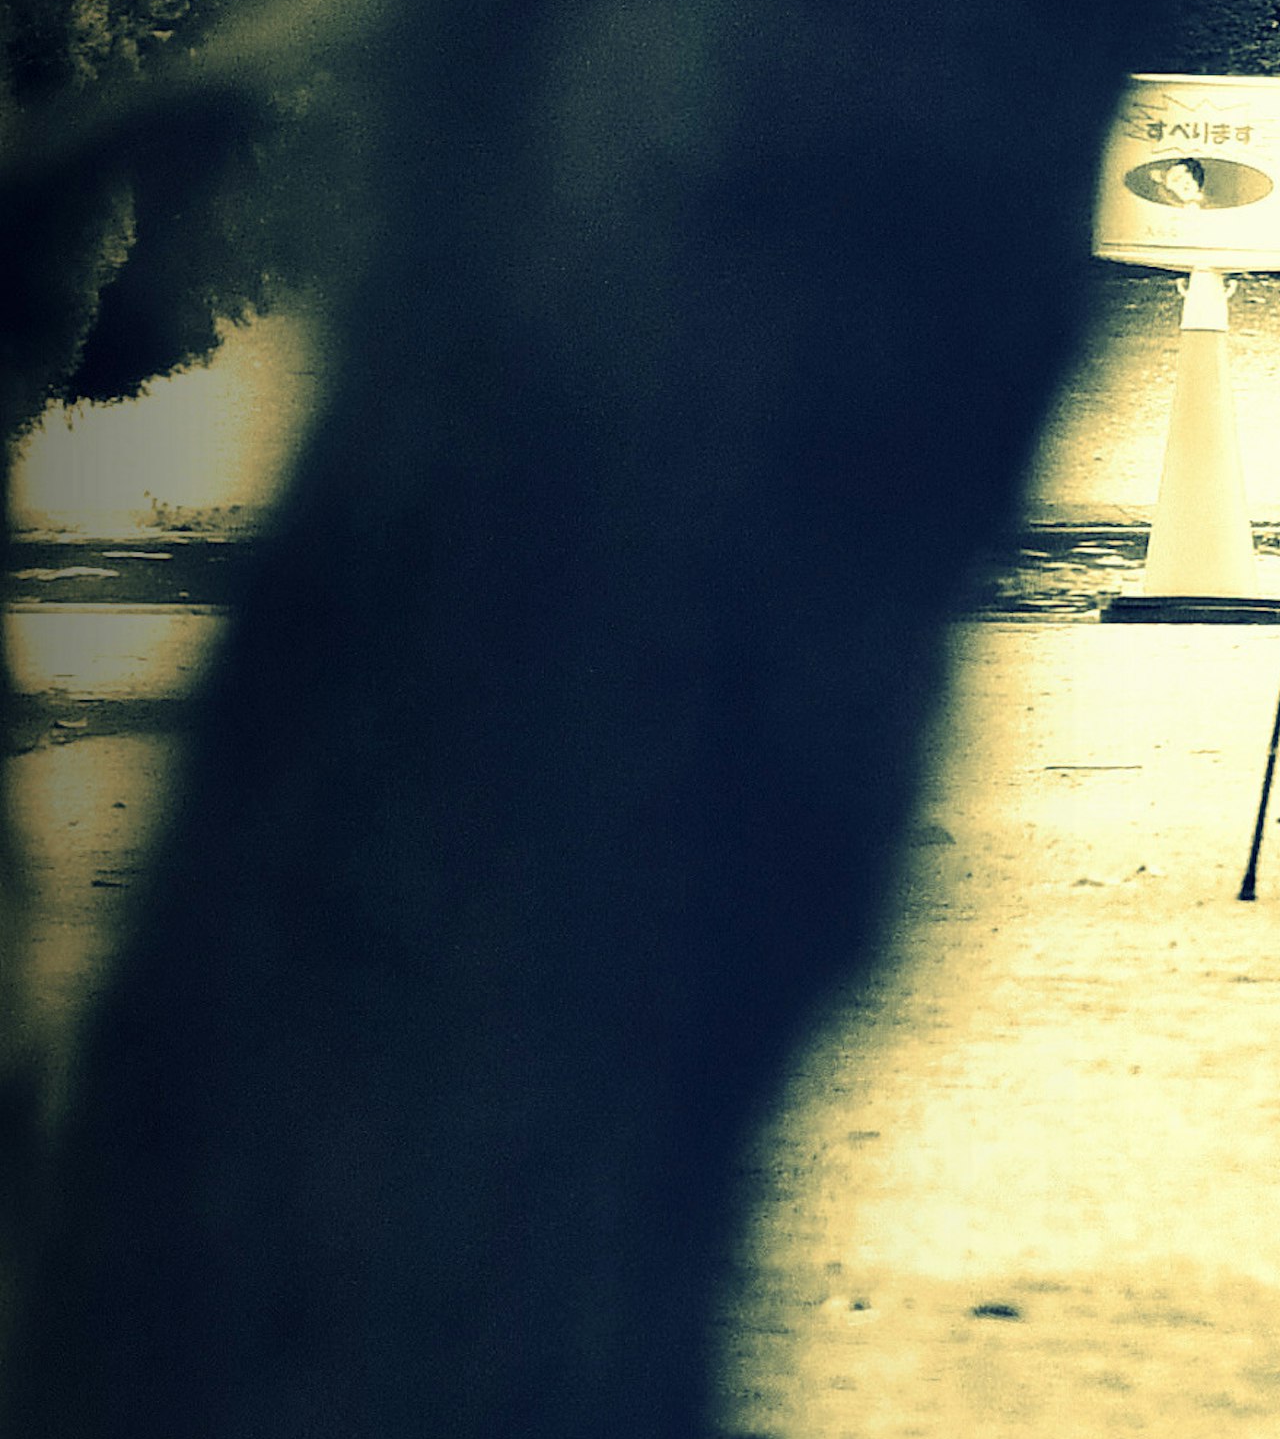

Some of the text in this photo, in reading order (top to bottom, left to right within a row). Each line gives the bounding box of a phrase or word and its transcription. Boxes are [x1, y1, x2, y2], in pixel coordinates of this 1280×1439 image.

[1146, 120, 1254, 145] すべります
